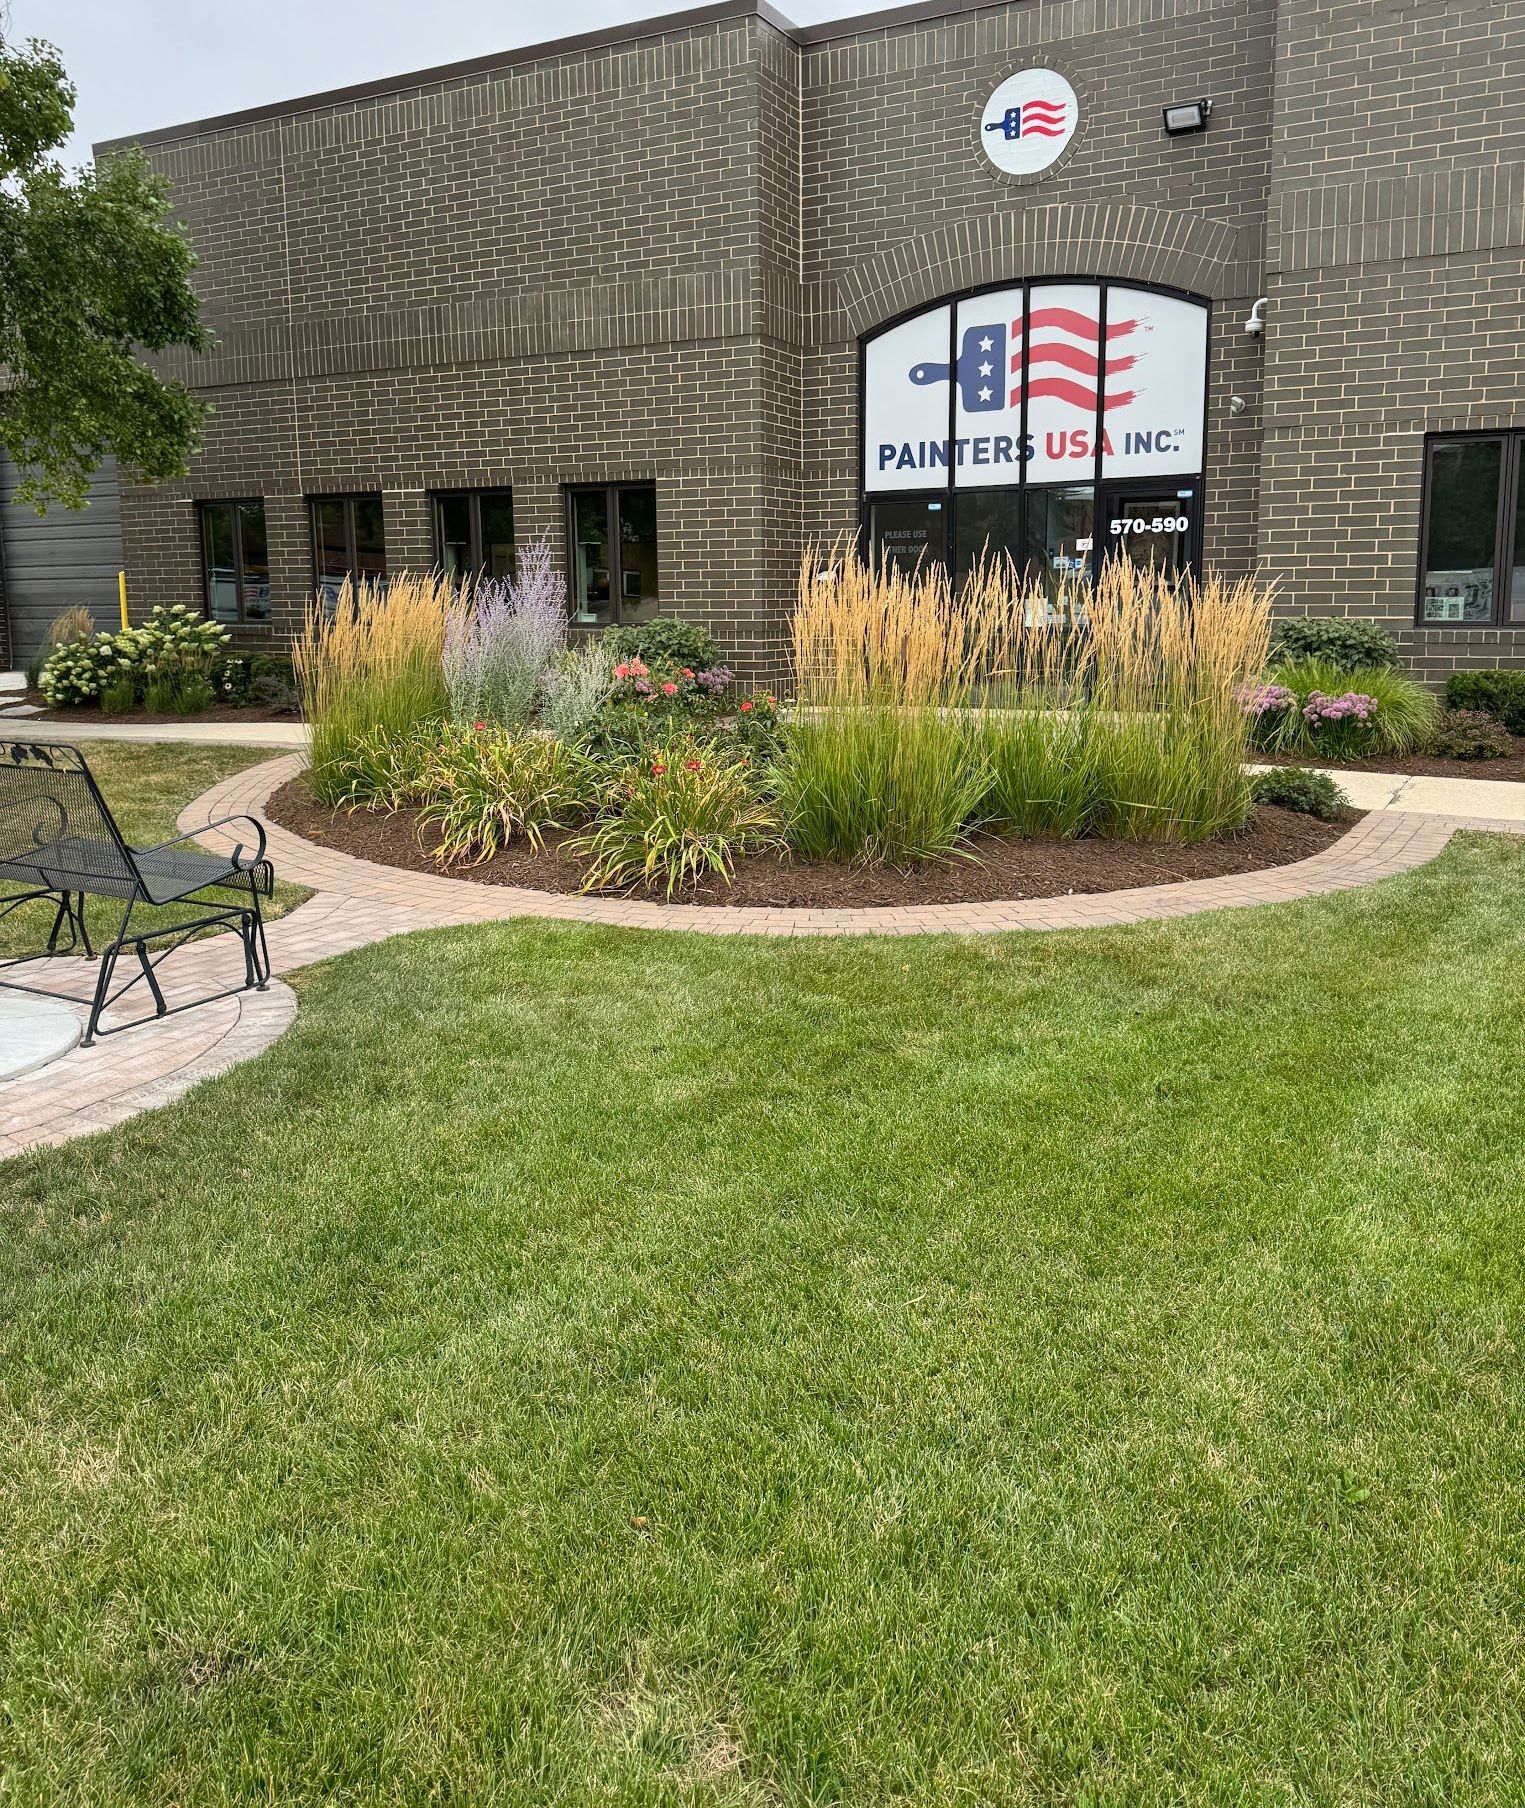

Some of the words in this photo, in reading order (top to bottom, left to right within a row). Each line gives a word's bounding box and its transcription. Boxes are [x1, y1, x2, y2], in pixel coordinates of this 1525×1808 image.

[879, 433, 1035, 470] PAINTERS
[1046, 428, 1115, 460] USA
[1124, 430, 1179, 455] INC.
[1109, 516, 1189, 535] 570-590
[884, 530, 912, 539] PLEASE
[913, 529, 928, 538] USE
[884, 545, 907, 554] THER
